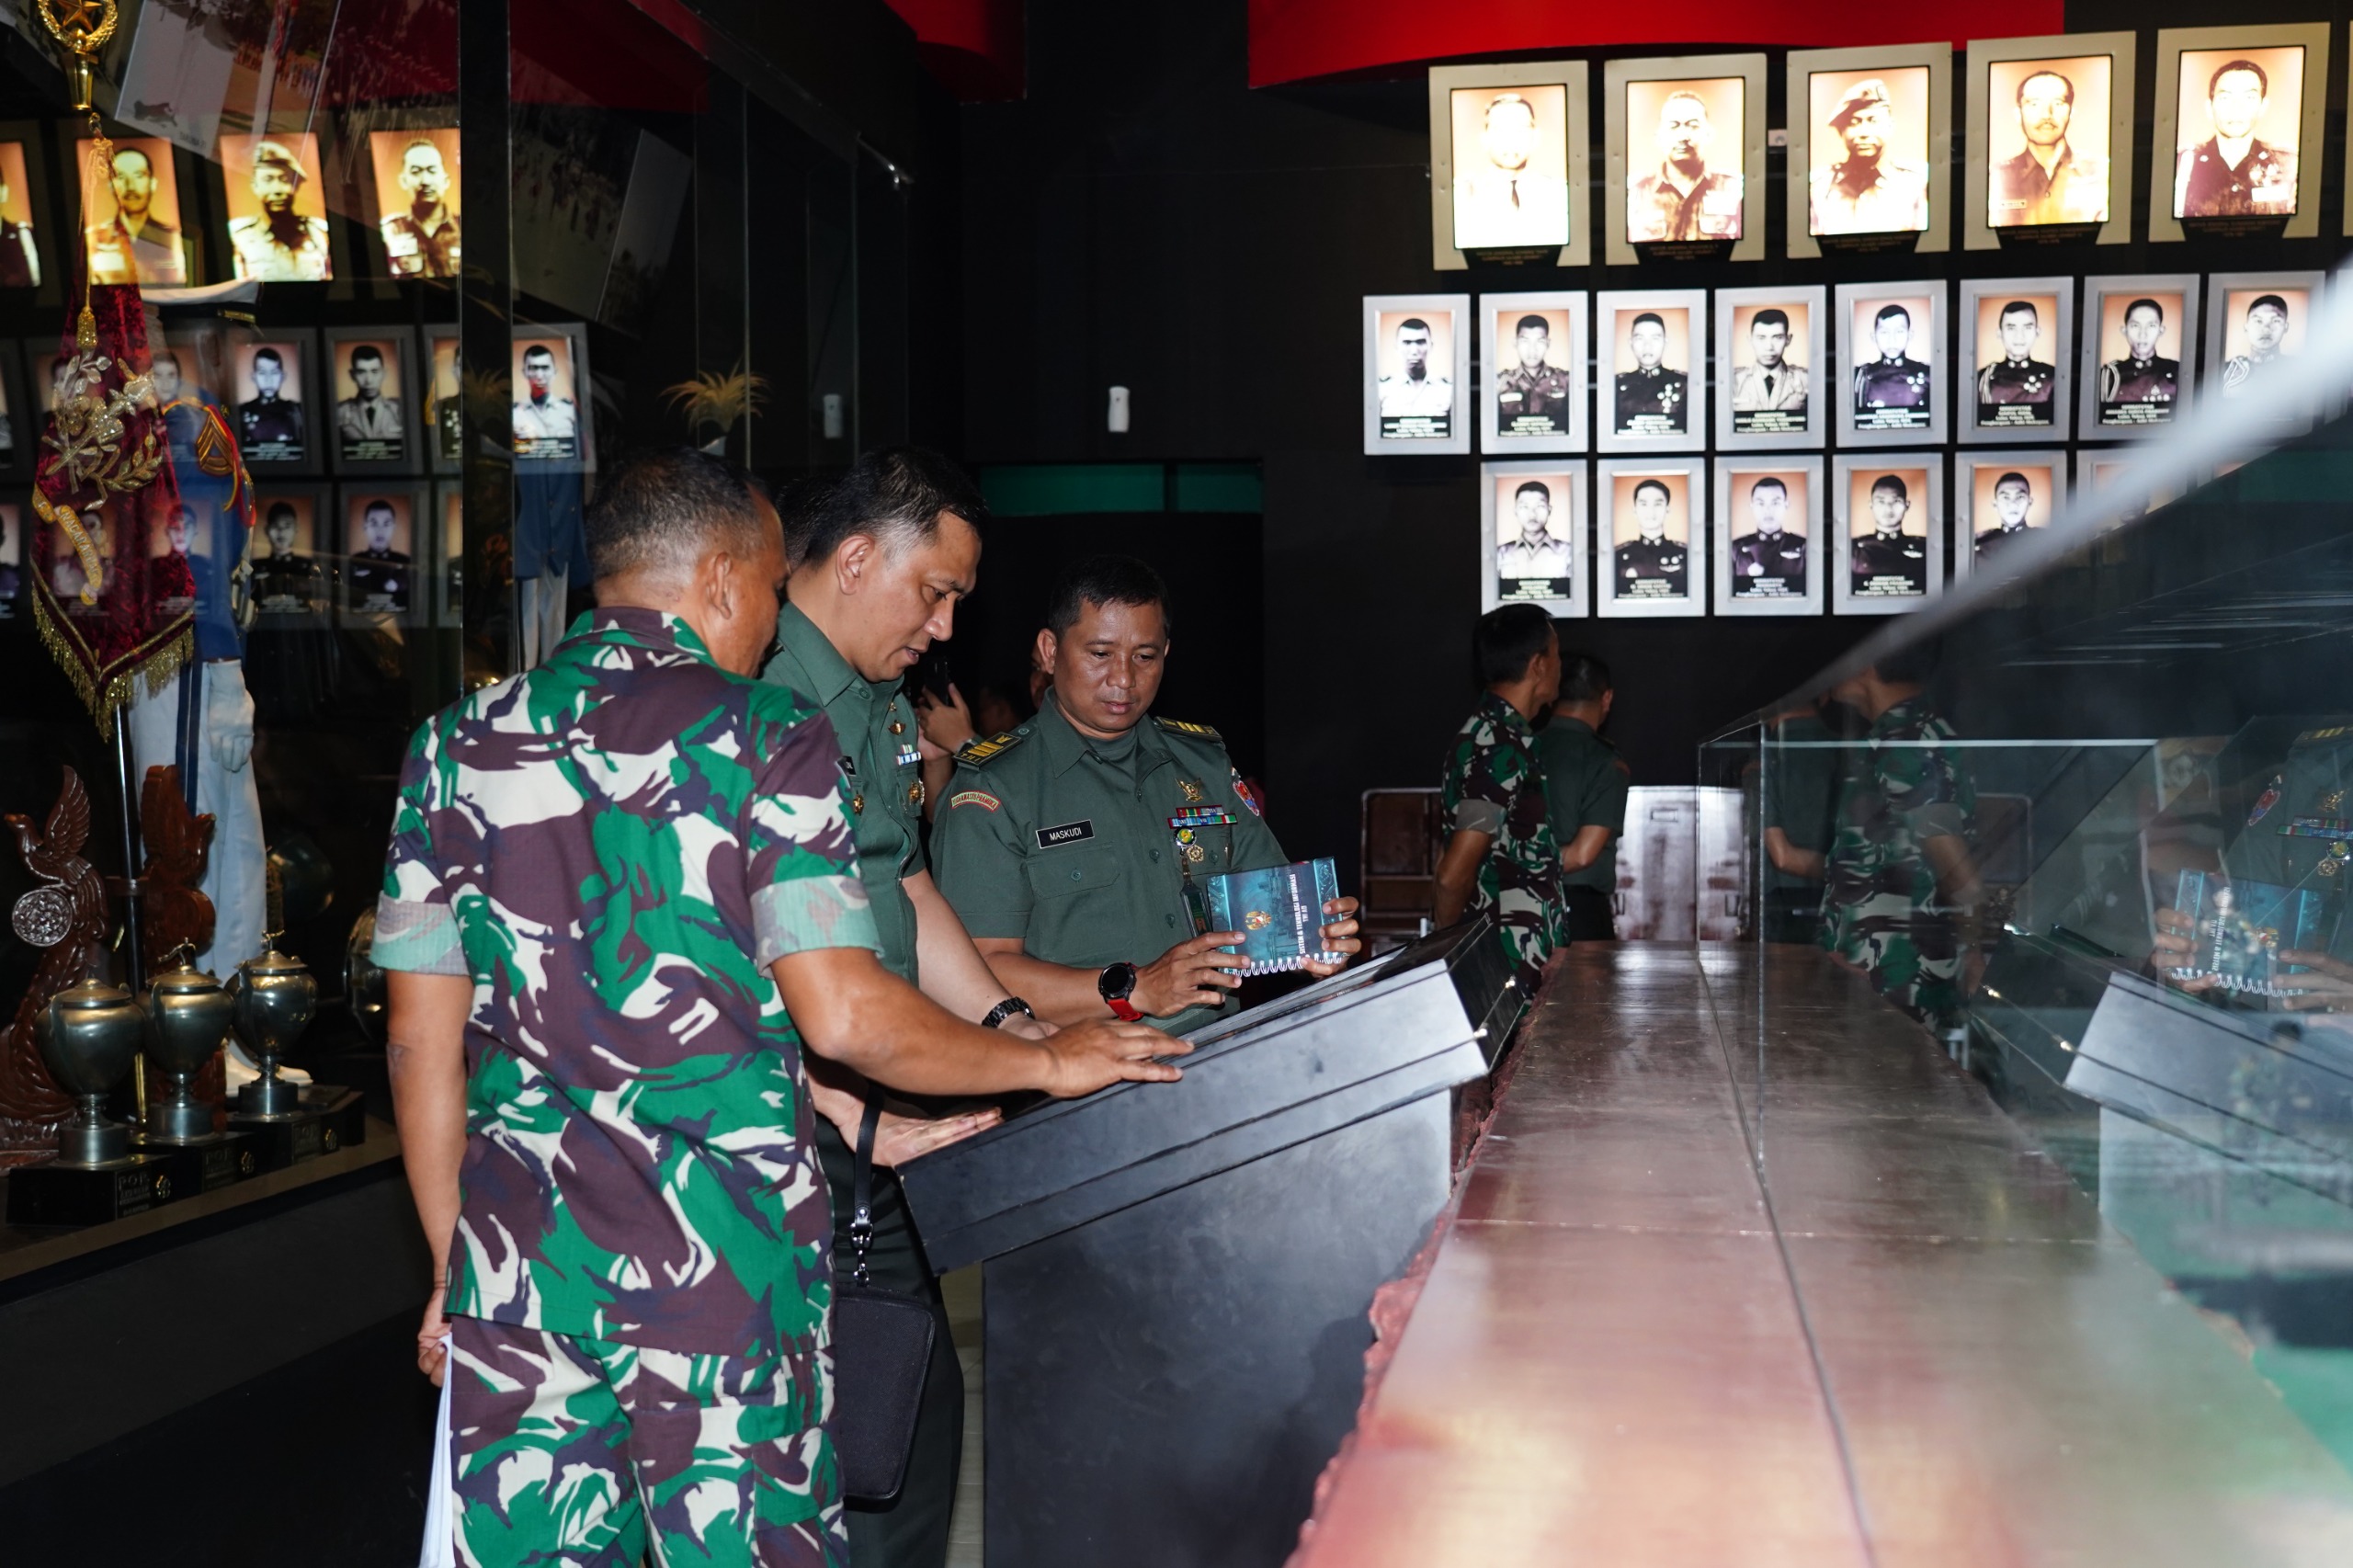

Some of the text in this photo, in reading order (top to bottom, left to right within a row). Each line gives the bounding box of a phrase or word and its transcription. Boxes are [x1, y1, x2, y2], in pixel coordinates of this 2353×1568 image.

[1049, 827, 1082, 841] MASKUDI
[1290, 874, 1298, 902] INFORMASI
[1294, 903, 1302, 929] TEKNOLOGI
